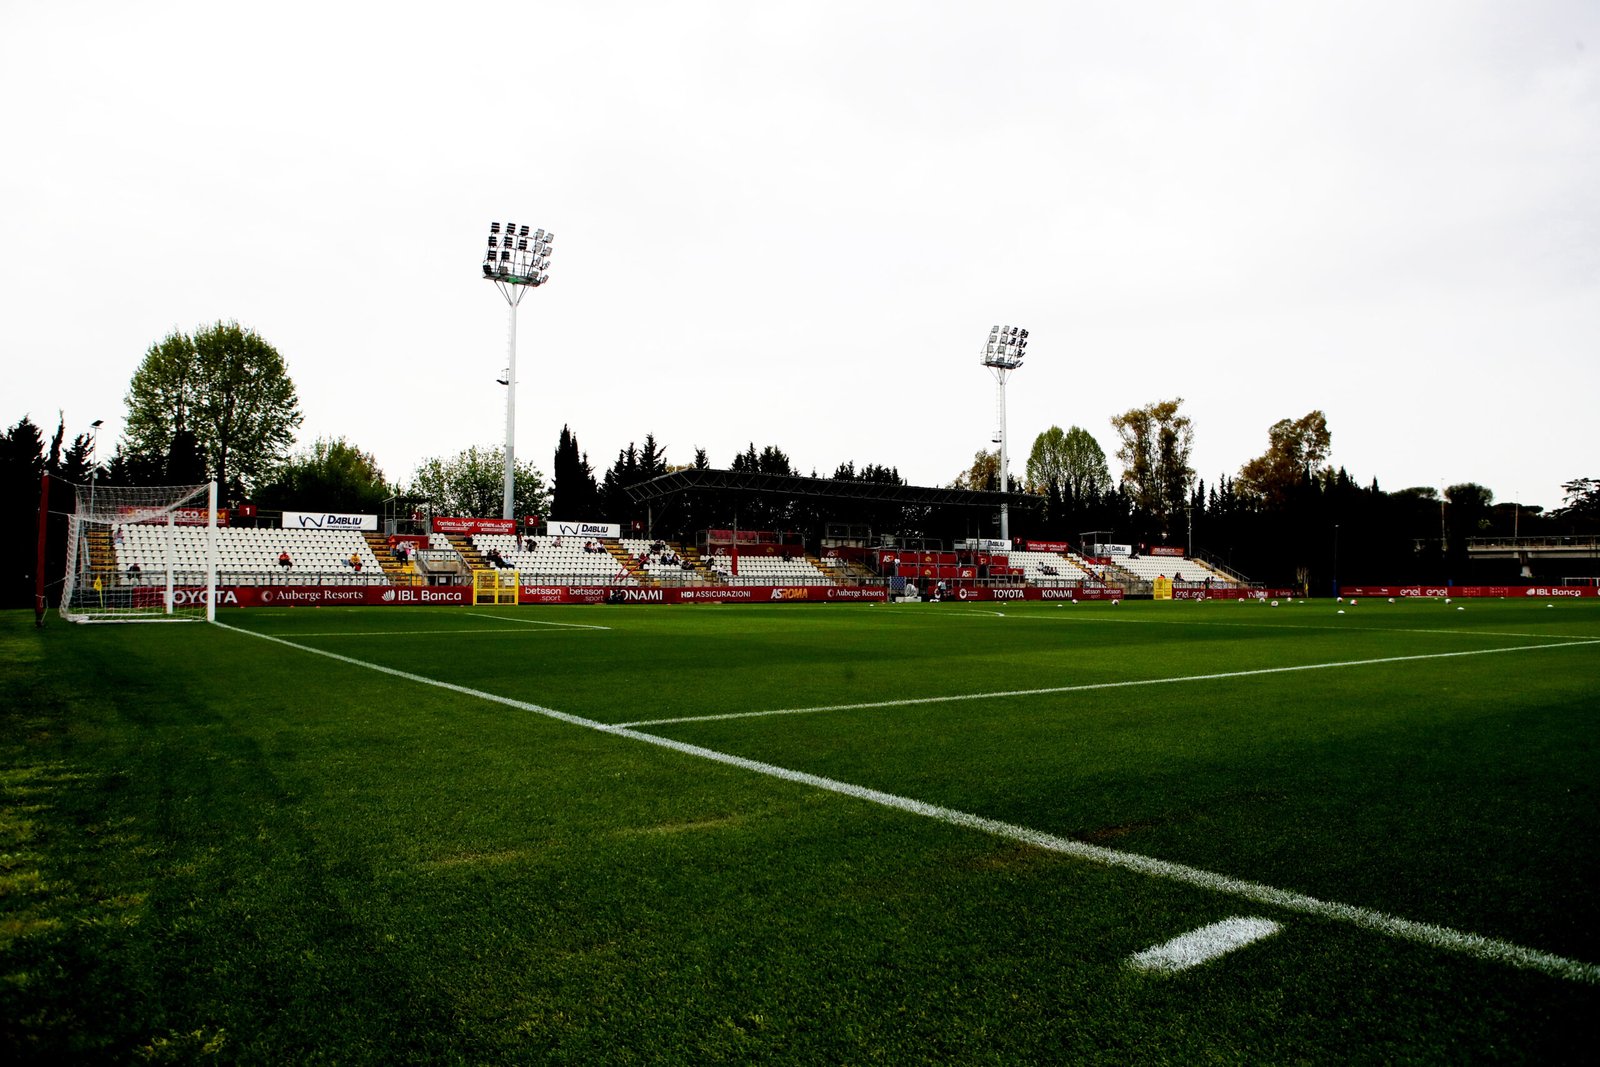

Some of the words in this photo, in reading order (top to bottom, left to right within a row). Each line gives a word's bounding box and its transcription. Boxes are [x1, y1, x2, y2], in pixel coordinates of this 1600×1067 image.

[245, 507, 250, 515] 1
[327, 515, 362, 525] DABLIU
[582, 524, 608, 533] DABLIU
[525, 586, 561, 595] betsson
[570, 587, 604, 595] betsson
[836, 589, 860, 598] Auberge
[993, 590, 1024, 598] TOYOTA
[1042, 590, 1072, 598] KONAMI
[1400, 588, 1421, 596] enel
[1426, 588, 1448, 596] enel
[1552, 588, 1581, 596] Banca
[276, 590, 321, 602] Auberge
[324, 590, 363, 600] Resorts
[398, 590, 418, 601] IBL
[422, 590, 462, 601] Banca
